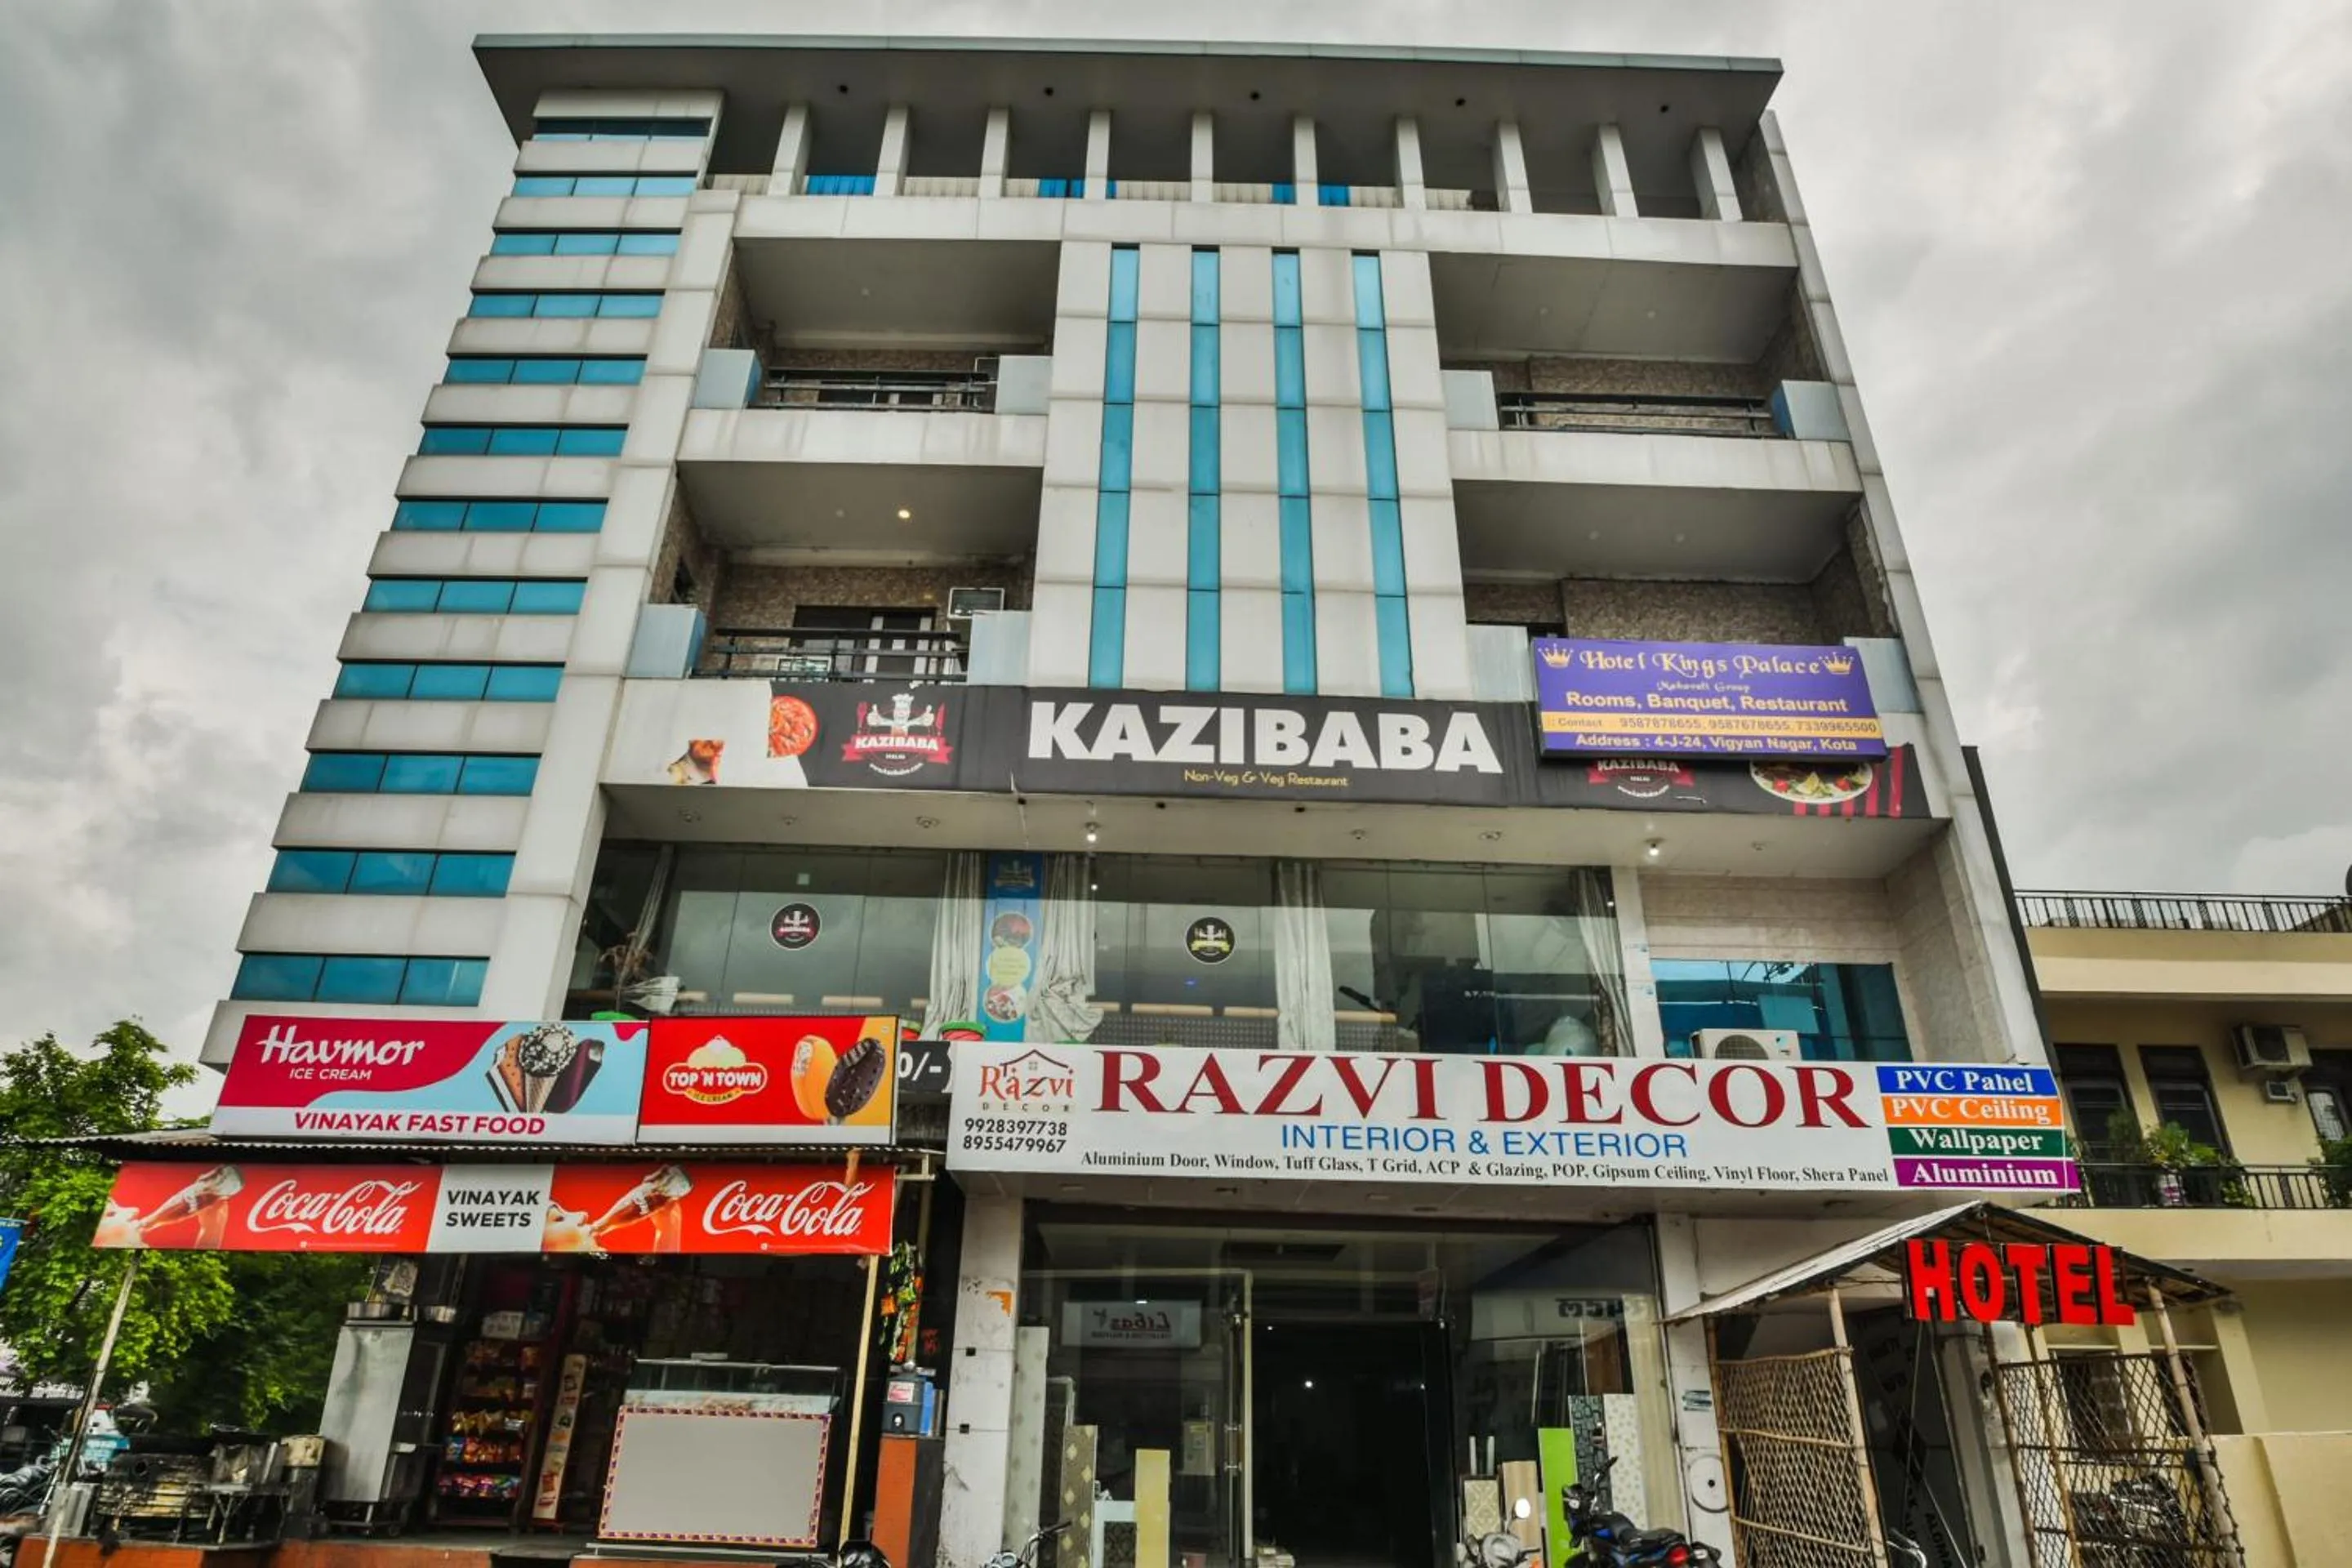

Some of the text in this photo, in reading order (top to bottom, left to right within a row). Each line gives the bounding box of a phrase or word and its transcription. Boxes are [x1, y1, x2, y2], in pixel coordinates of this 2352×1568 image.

[1579, 650, 1821, 679] Hotel Kings Palace
[1566, 691, 1849, 712] Rooms, Banquet, Restaurant
[1557, 717, 1603, 726] Contact
[854, 736, 939, 751] KAZIBABA
[1028, 701, 1503, 774] KAZIBABA
[1575, 734, 1642, 747] Address
[1709, 737, 1763, 751] Vigyan
[1766, 738, 1818, 751] Nagar,
[1820, 738, 1858, 751] Kota
[1597, 759, 1681, 773] KAZIBABA
[1184, 769, 1349, 788] Non-Veg & Veg Restaurant
[289, 1067, 372, 1081] ICE CREAM
[669, 1072, 699, 1086] TOP
[716, 1071, 762, 1087] TOWN
[978, 1065, 1075, 1101] Razvi
[1895, 1070, 1956, 1090] PVC
[1092, 1050, 1872, 1129] RAZVI DECOR
[982, 1102, 1070, 1111] DECOR
[1891, 1098, 2051, 1124] PVC Ceiling
[294, 1111, 545, 1135] VINAYAK FAST FOOD
[964, 1117, 1068, 1136] 9928397738
[963, 1135, 1067, 1153] 8955479967
[1282, 1125, 1688, 1159] INTERIOR & EXTERIOR
[1908, 1128, 2043, 1155] Wallpaper
[1080, 1151, 1165, 1167] Aluminium
[1170, 1153, 1210, 1169] Door,
[1214, 1154, 1280, 1170] Window,
[1283, 1156, 1314, 1170] Tuff
[1318, 1157, 1364, 1173] Glass,
[1367, 1158, 1378, 1172] T
[1383, 1158, 1423, 1174] Grid,
[1426, 1160, 1460, 1174] ACP
[1468, 1162, 1481, 1175] &
[1486, 1162, 1549, 1180] Glazing,
[1552, 1164, 1589, 1178] POP,
[1592, 1165, 1650, 1182] Gipsum
[1655, 1165, 1711, 1182] Ceiling,
[1713, 1165, 1753, 1183] Vinyl
[1802, 1167, 1845, 1181] Shera
[1849, 1168, 1889, 1183] Panel
[1912, 1163, 2059, 1184] Aluminium
[448, 1190, 541, 1205] VINAYAK
[445, 1212, 532, 1227] SWEETS
[1904, 1239, 2136, 1326] HOTEL
